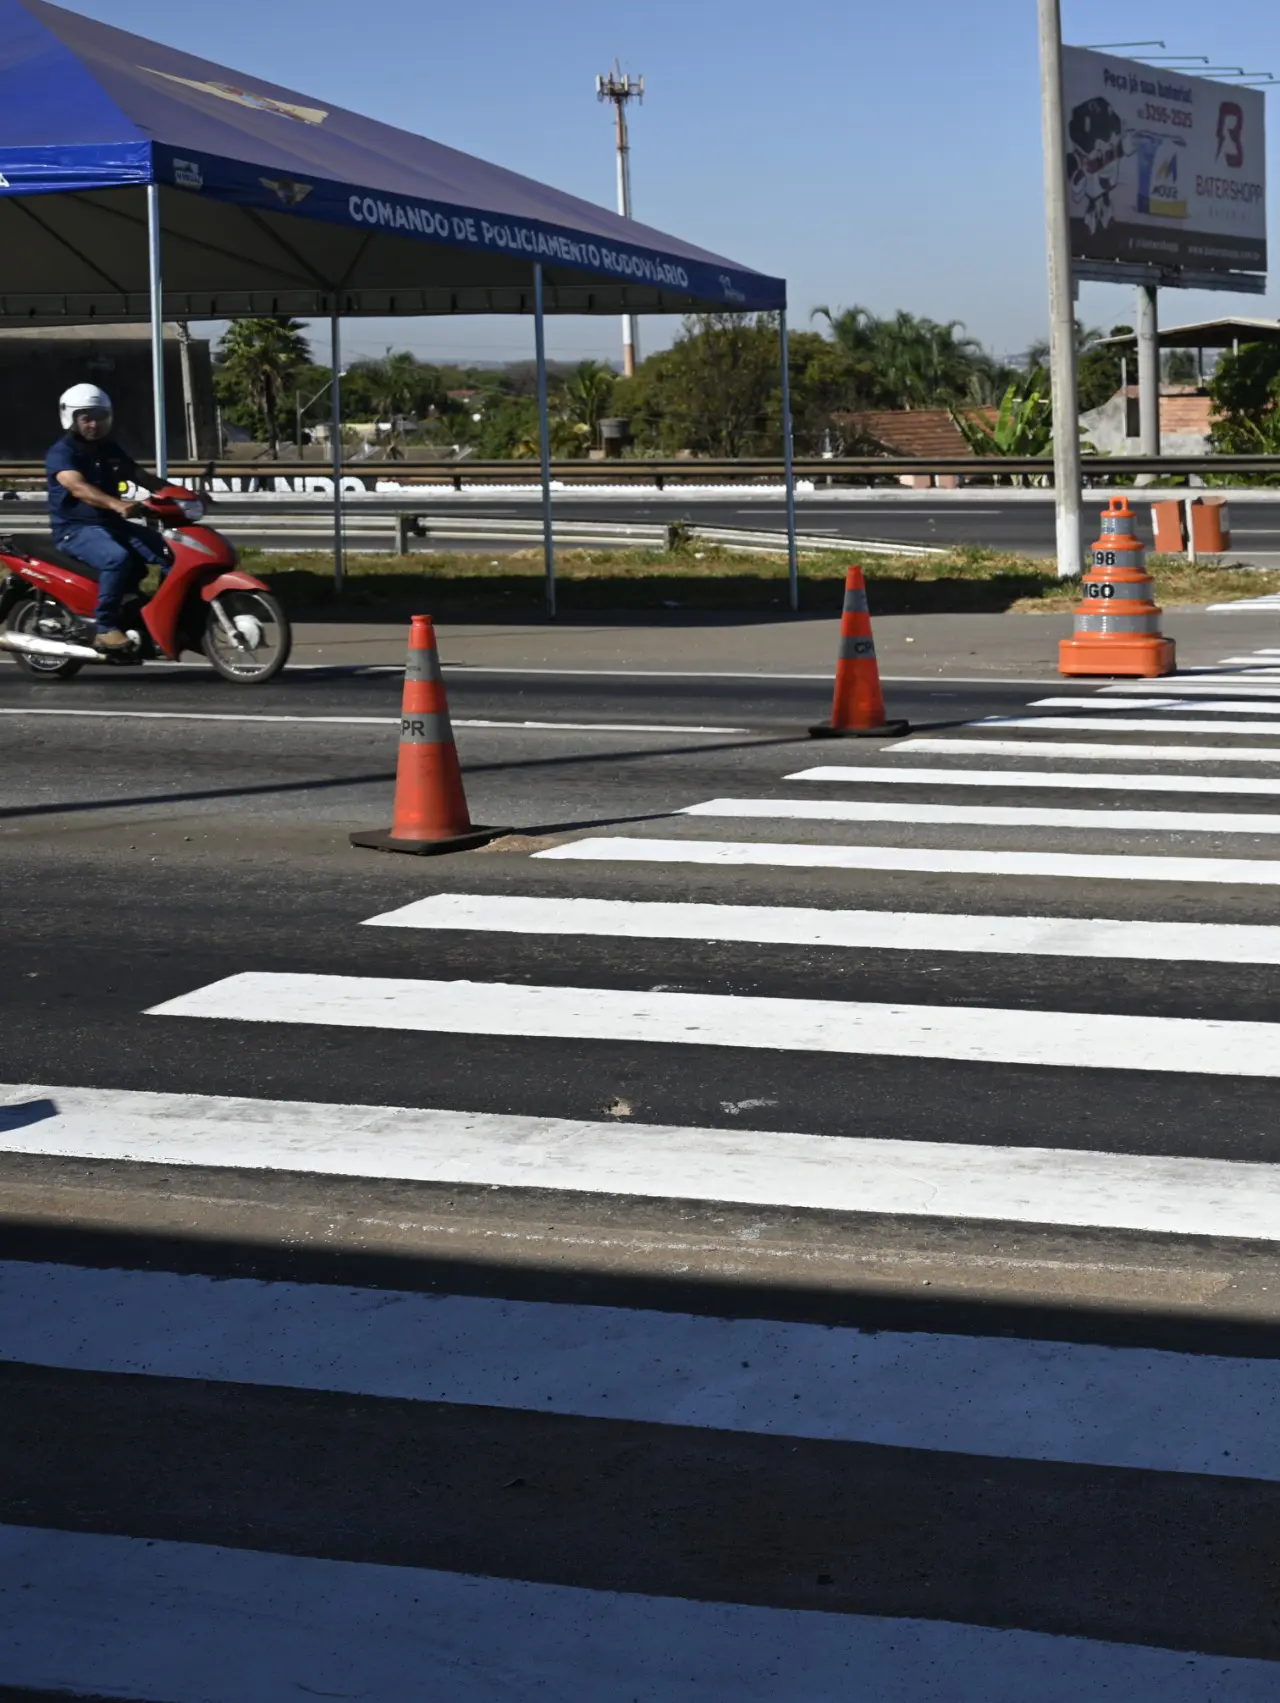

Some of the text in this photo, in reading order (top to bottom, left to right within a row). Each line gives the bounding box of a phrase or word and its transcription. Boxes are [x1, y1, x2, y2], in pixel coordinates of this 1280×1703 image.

[348, 194, 450, 238] COMANDO
[452, 216, 479, 242] DE
[479, 219, 601, 268] POLICIAMENTO
[601, 247, 689, 289] RODOVIÁRIO
